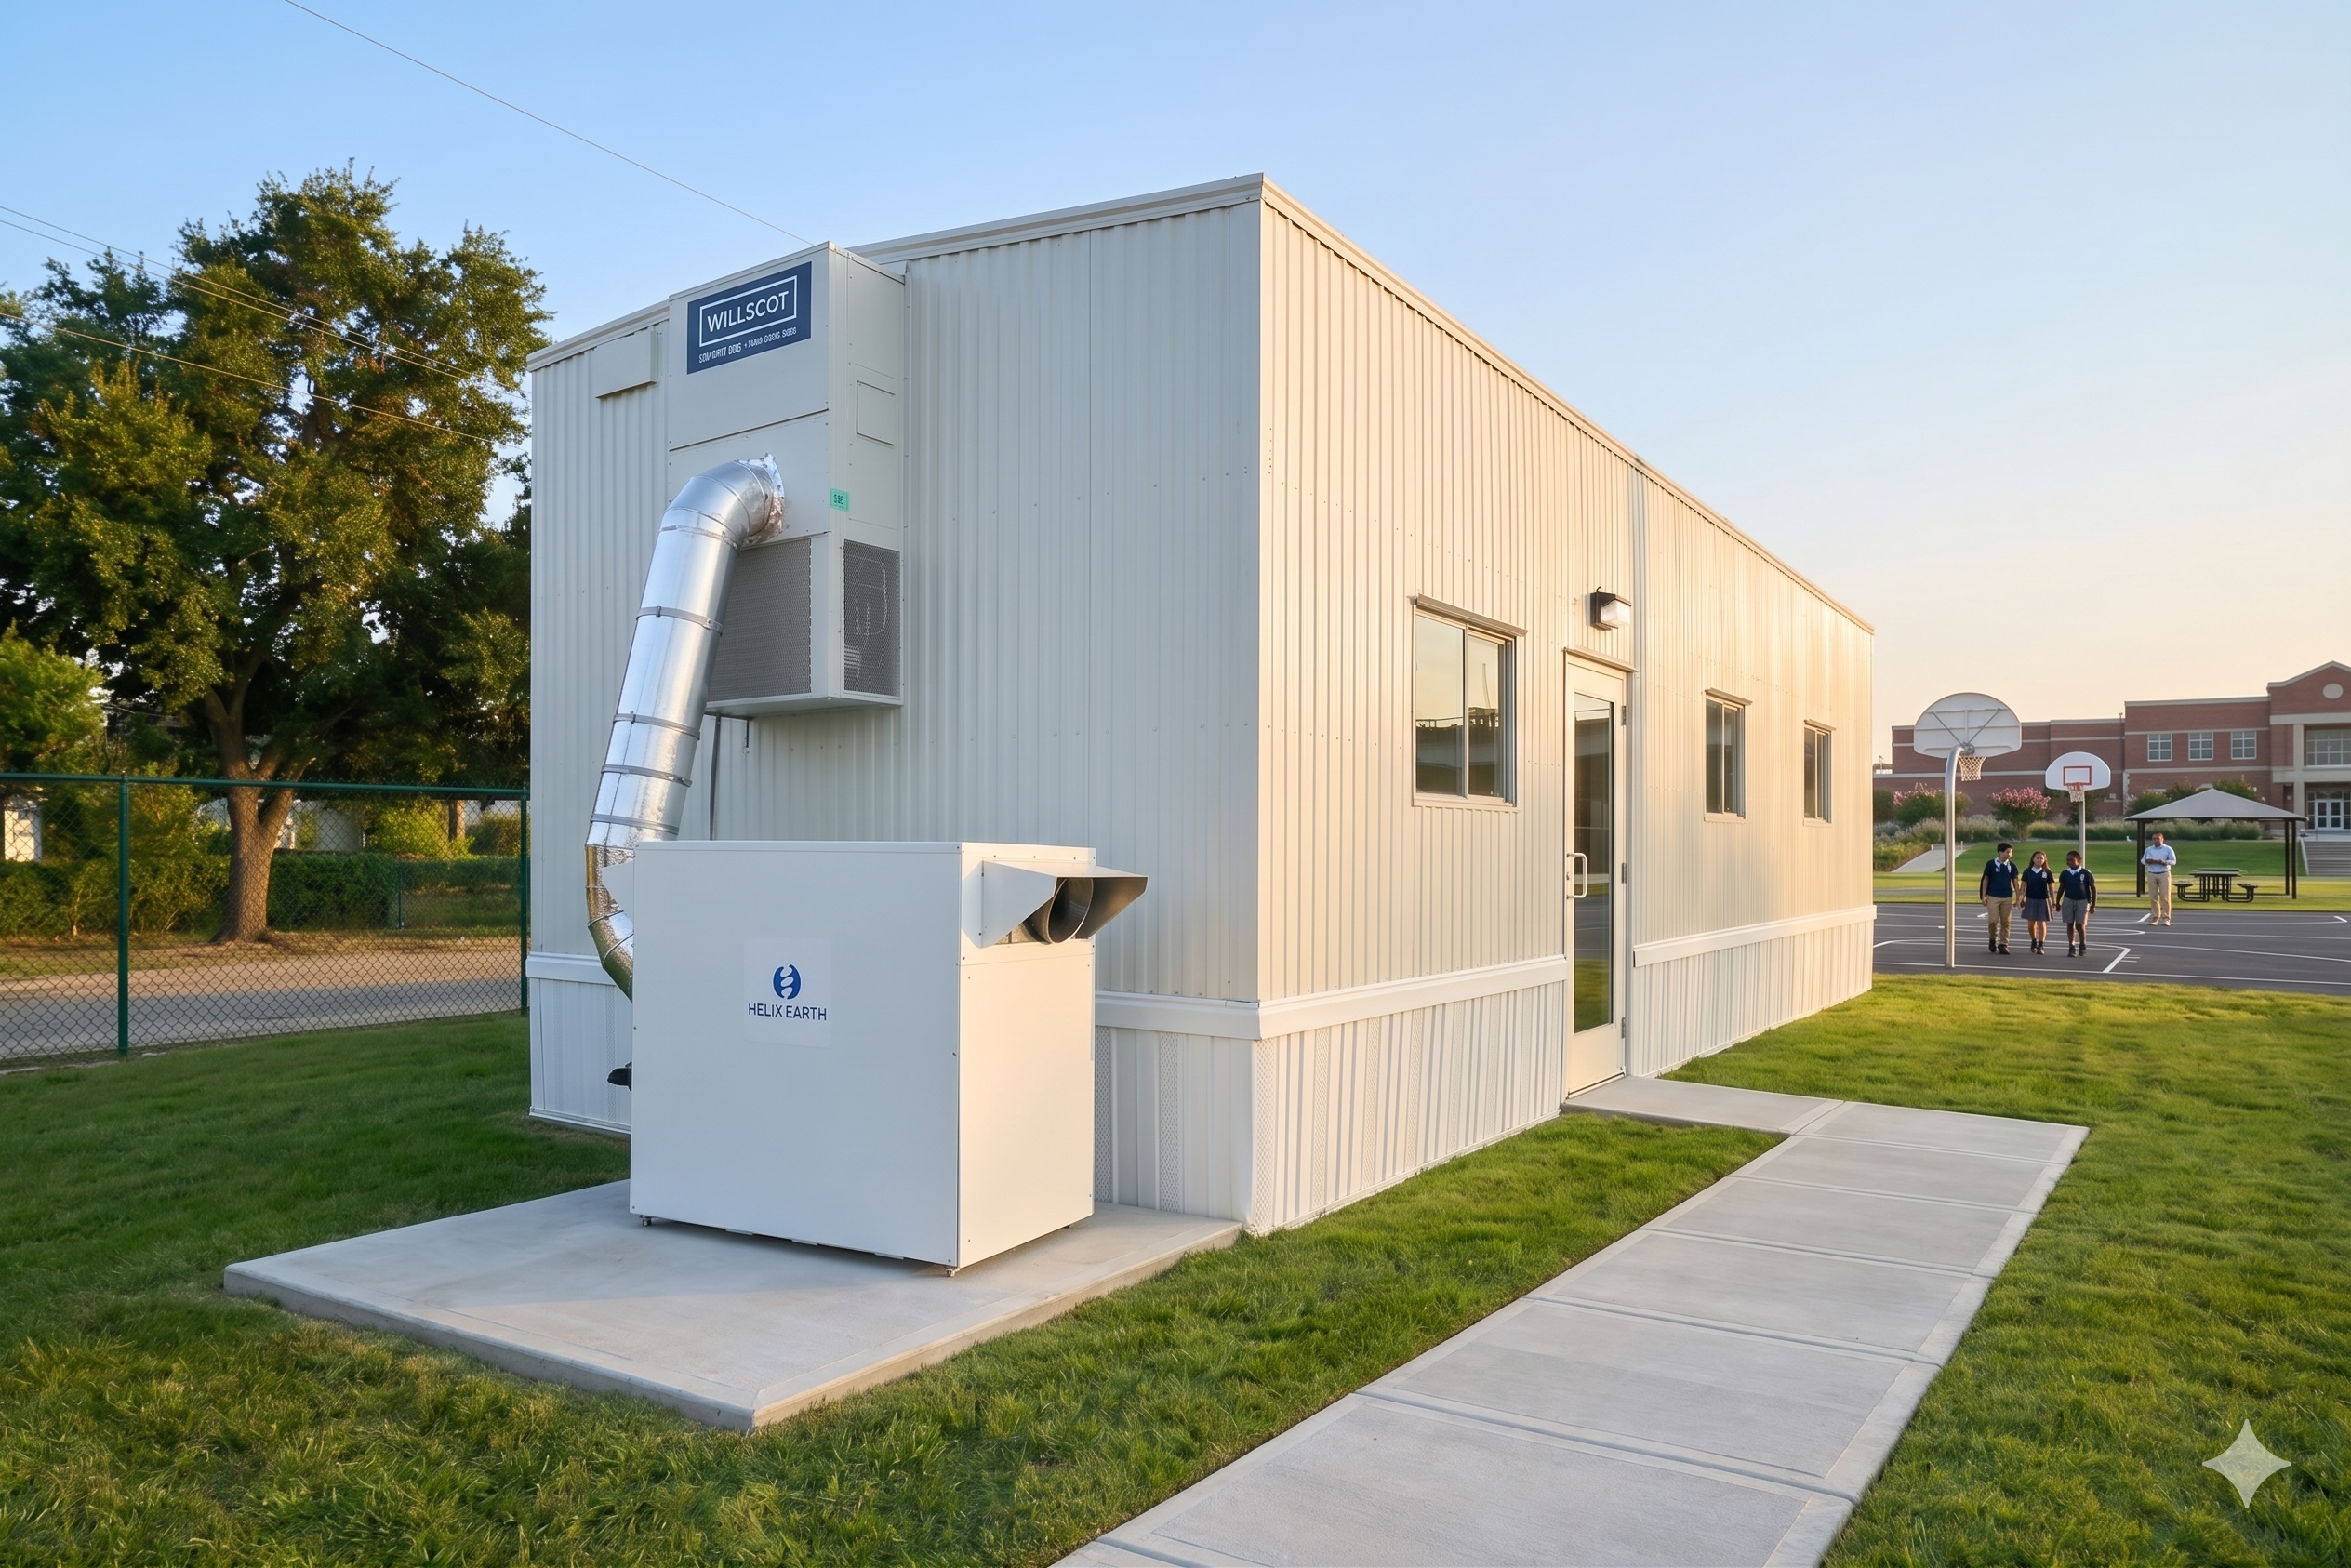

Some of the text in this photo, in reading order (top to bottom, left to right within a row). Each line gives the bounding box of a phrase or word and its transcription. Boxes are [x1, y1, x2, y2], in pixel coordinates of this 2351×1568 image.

[707, 290, 790, 333] WILLSCOT
[748, 1003, 827, 1021] HELIX EARTH
